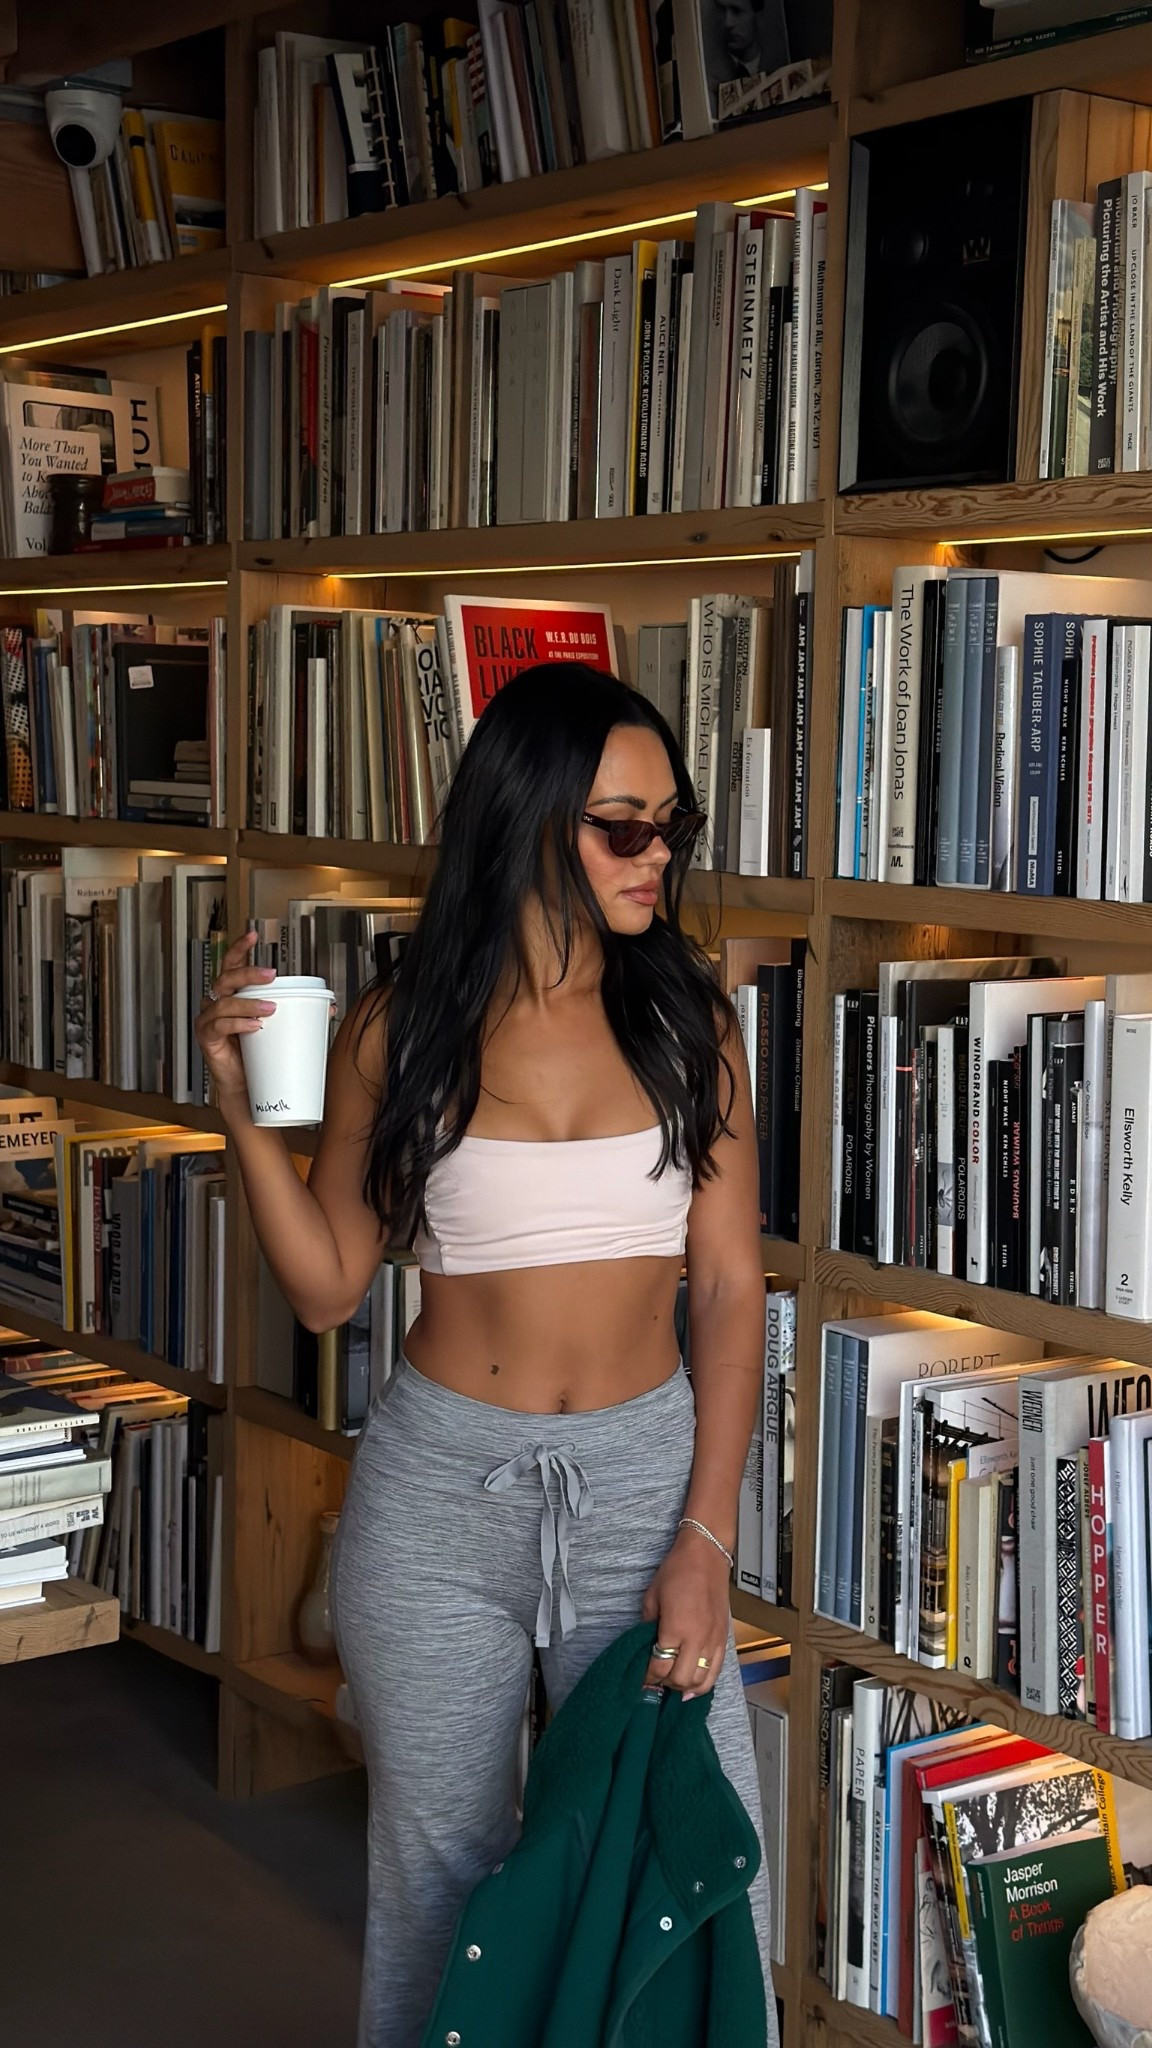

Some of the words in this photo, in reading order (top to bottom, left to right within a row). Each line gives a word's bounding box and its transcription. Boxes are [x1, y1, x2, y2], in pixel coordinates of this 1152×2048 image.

[1131, 195, 1138, 205] JO
[1100, 199, 1113, 262] Picturing
[1130, 250, 1137, 261] UP
[612, 268, 623, 297] Dark
[1101, 264, 1111, 287] the
[815, 260, 826, 325] Muhammad
[1099, 289, 1111, 328] Artist
[1130, 292, 1137, 302] IN
[611, 300, 622, 332] Light
[741, 243, 757, 380] STEINMETZ
[644, 319, 652, 340] JORN
[658, 315, 667, 347] ALICE
[1099, 330, 1109, 355] and
[642, 350, 651, 386] POLLOCK
[657, 350, 666, 376] NEEL
[1098, 358, 1107, 380] His
[1129, 349, 1136, 359] OF
[321, 383, 330, 408] and
[1097, 381, 1107, 418] Work
[321, 412, 330, 432] the
[640, 388, 649, 450] REVOLUTIONARY
[756, 404, 766, 433] Lange
[19, 437, 51, 453] More
[54, 440, 85, 456] Than
[21, 453, 42, 468] You
[46, 456, 89, 472] Wanted
[320, 436, 330, 461] Age
[22, 470, 32, 482] to
[639, 452, 647, 478] ROADS
[901, 584, 915, 621] The
[474, 625, 539, 660] BLACK
[569, 632, 580, 644] DU
[703, 601, 714, 656] WHO
[798, 624, 806, 647] JAM
[1033, 621, 1045, 666] SOPHIE
[742, 618, 750, 676] SELECTION
[797, 650, 805, 673] JAM
[899, 624, 913, 677] Work
[702, 660, 712, 680] IS
[796, 675, 805, 700] JAM
[898, 680, 911, 700] of
[796, 701, 804, 726] JAM
[896, 703, 910, 745] Joan
[1031, 669, 1044, 753] TAEUBER-ARP
[698, 684, 711, 777] MICHAEL
[795, 727, 804, 752] JAM
[731, 741, 739, 793] EDITIONS
[795, 753, 803, 777] JAM
[995, 732, 1006, 772] Radical
[744, 752, 753, 798] formation
[794, 779, 803, 803] JAM
[894, 748, 908, 801] Jonas
[994, 775, 1005, 808] Vision
[793, 805, 802, 829] JAM
[796, 968, 804, 989] Blue
[795, 989, 803, 1027] Tailoring
[760, 993, 770, 1058] PICASSO
[794, 1038, 802, 1073] Stefano
[865, 1015, 875, 1071] Pioneers
[760, 1060, 769, 1092] AND
[958, 1054, 967, 1095] BRIGID
[972, 1037, 981, 1117] WINOGRAND
[759, 1095, 768, 1140] PAPER
[863, 1073, 874, 1140] Photography
[971, 1120, 980, 1165] COLOR
[1013, 1121, 1021, 1165] WEIMAR
[1083, 1120, 1091, 1140] Edge
[1123, 1107, 1136, 1169] Ellsworth
[845, 1134, 854, 1195] POLAROIDS
[863, 1142, 875, 1157] by
[864, 1159, 874, 1200] Women
[957, 1157, 966, 1220] POLAROIDS
[1012, 1169, 1020, 1219] BAUHAUS
[1120, 1173, 1133, 1206] Kelly
[1121, 1274, 1129, 1286] 2
[765, 1308, 779, 1373] DOUG
[918, 1353, 1001, 1379] ROBERT
[765, 1373, 779, 1444] ARGUE
[1022, 1389, 1032, 1431] WEGNER
[1033, 1390, 1043, 1433] WEGNER
[1082, 1462, 1090, 1484] JOSEF
[1083, 1485, 1091, 1519] ALBERS
[1090, 1484, 1107, 1655] HOPPER
[820, 1675, 831, 1741] PICASSO
[820, 1742, 829, 1769] and
[854, 1748, 865, 1797] PAPER
[1095, 1772, 1108, 1810] College
[1003, 1862, 1044, 1885] Jasper
[1006, 1877, 1058, 1904] Morrison
[1009, 1907, 1019, 1923] A
[1020, 1900, 1052, 1919] Book
[1011, 1927, 1024, 1942] of
[1026, 1918, 1065, 1937] Things
